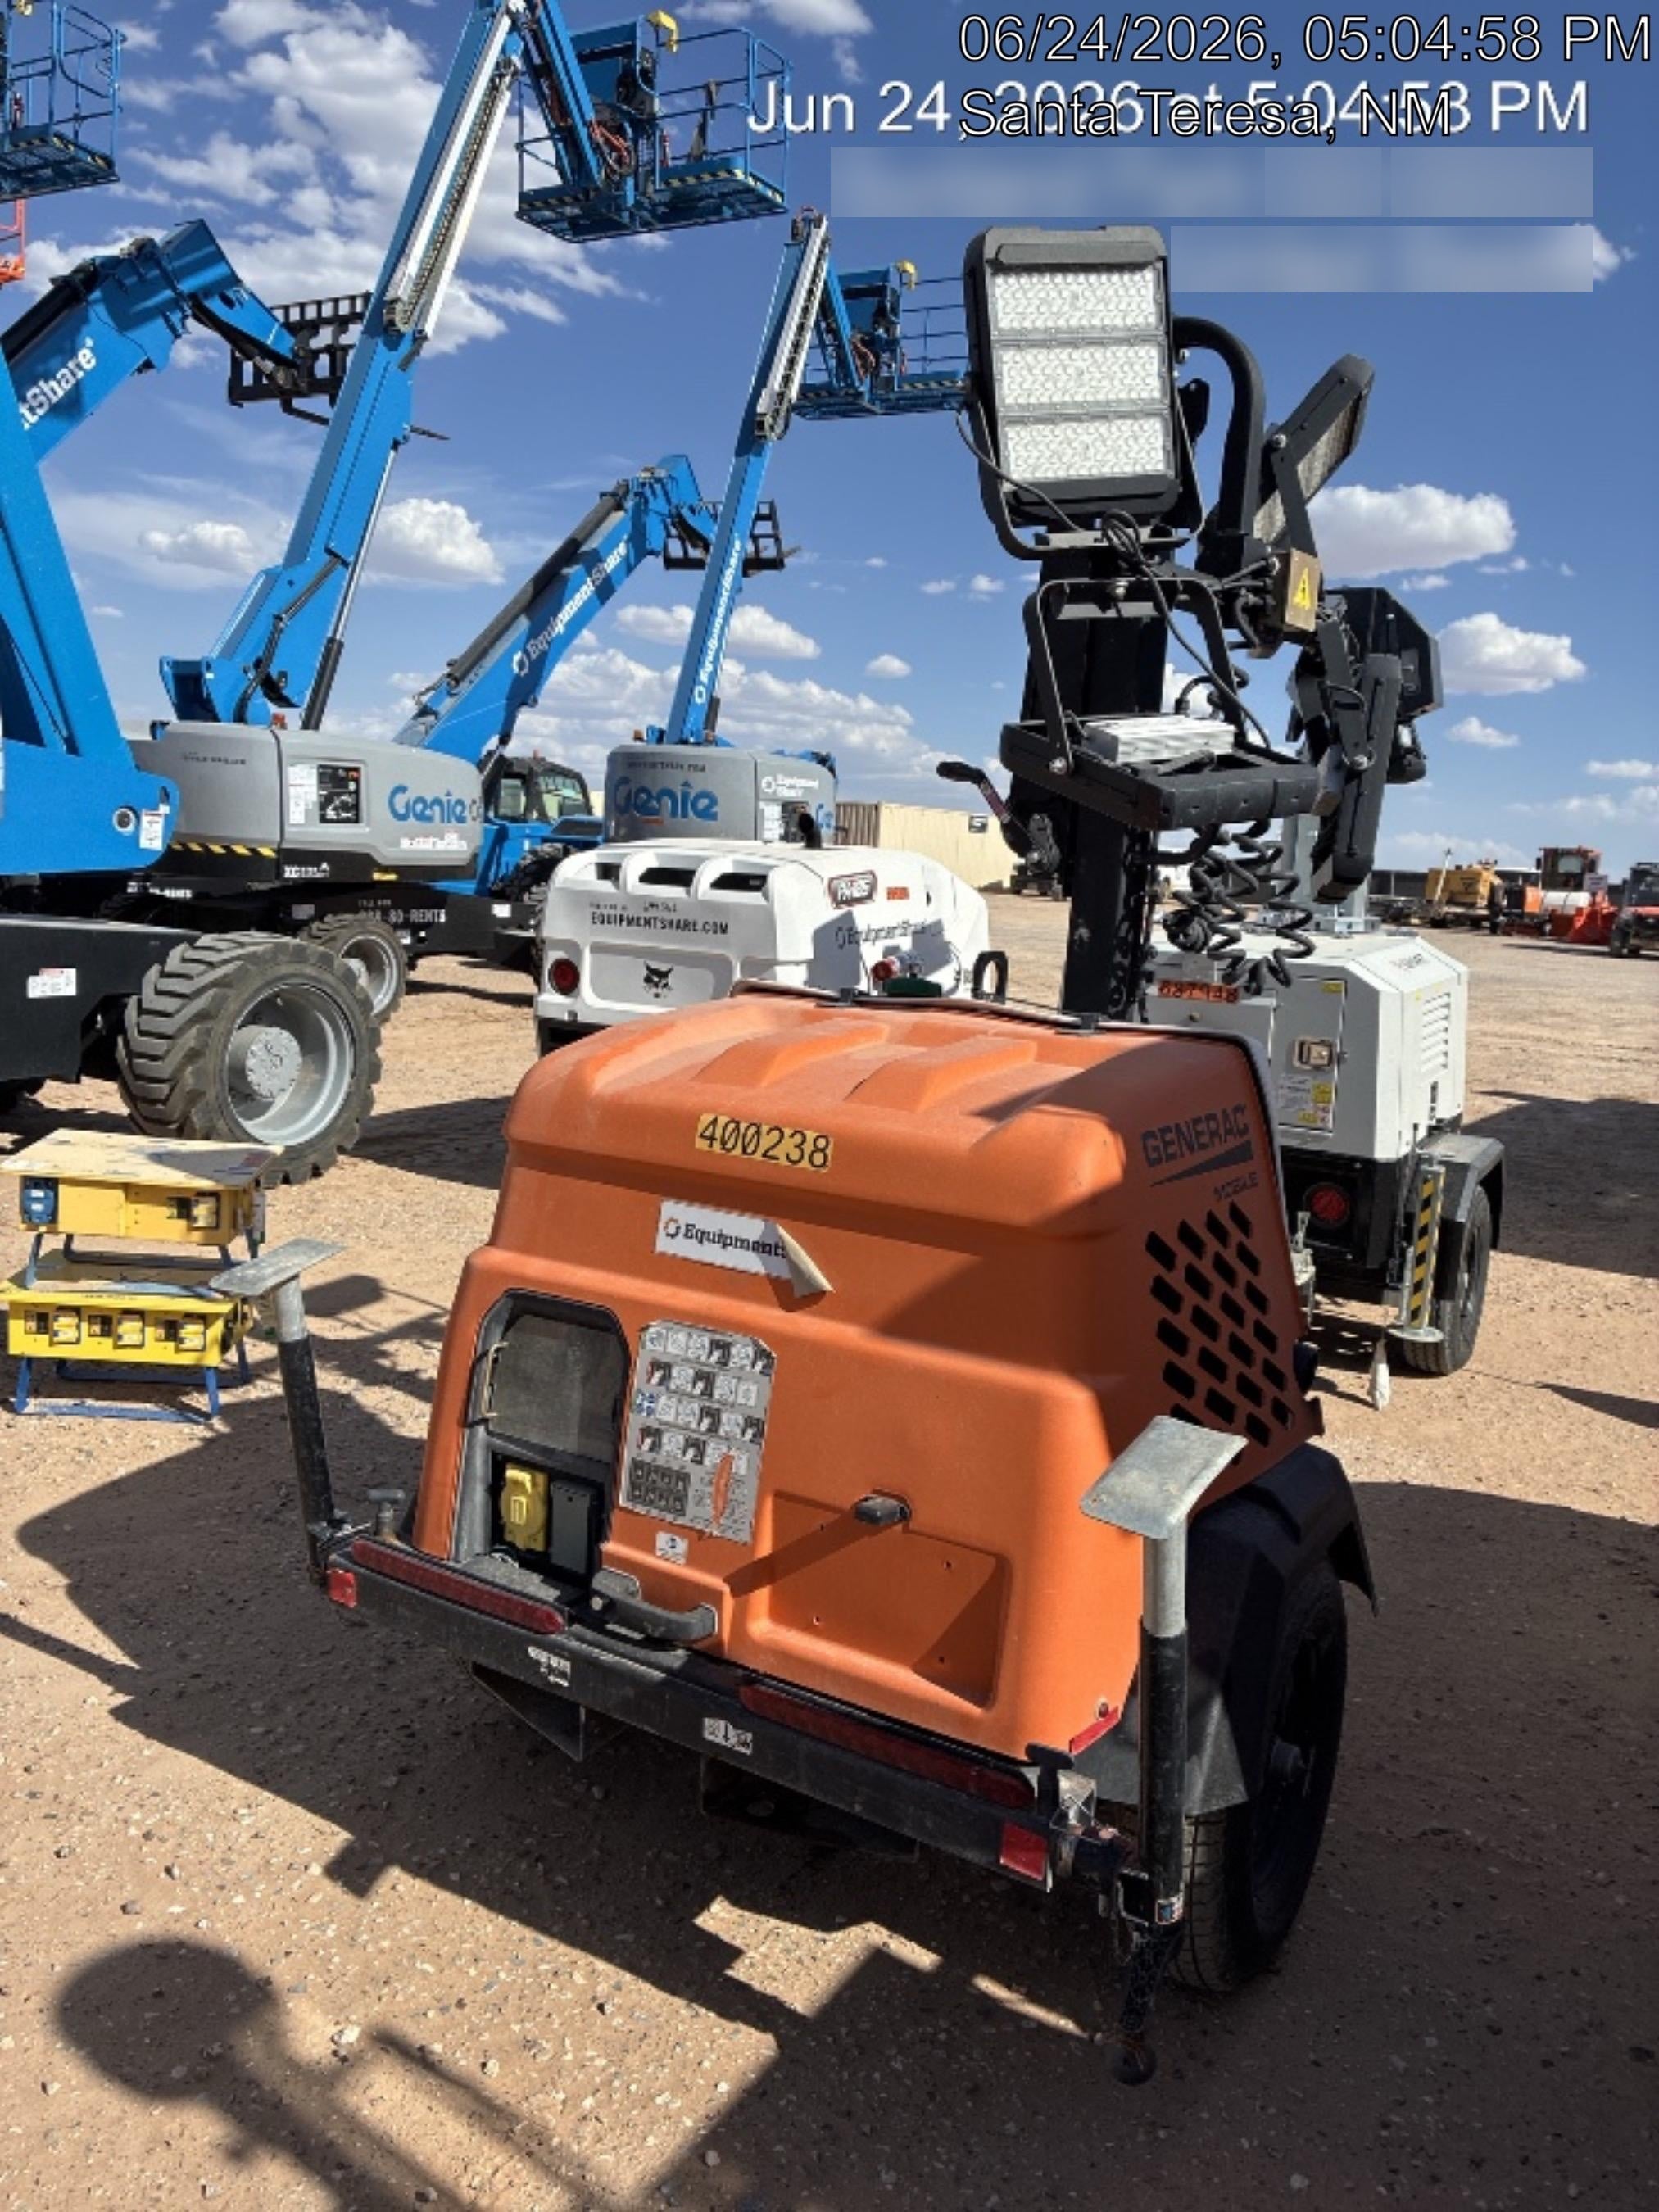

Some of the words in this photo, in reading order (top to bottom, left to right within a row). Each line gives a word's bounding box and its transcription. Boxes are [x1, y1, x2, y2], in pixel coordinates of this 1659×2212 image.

[19, 347, 97, 431] tShare
[388, 783, 468, 824] Genie
[614, 777, 719, 823] Genie
[698, 1114, 831, 1169] 400238
[1141, 1104, 1250, 1168] GENERAC
